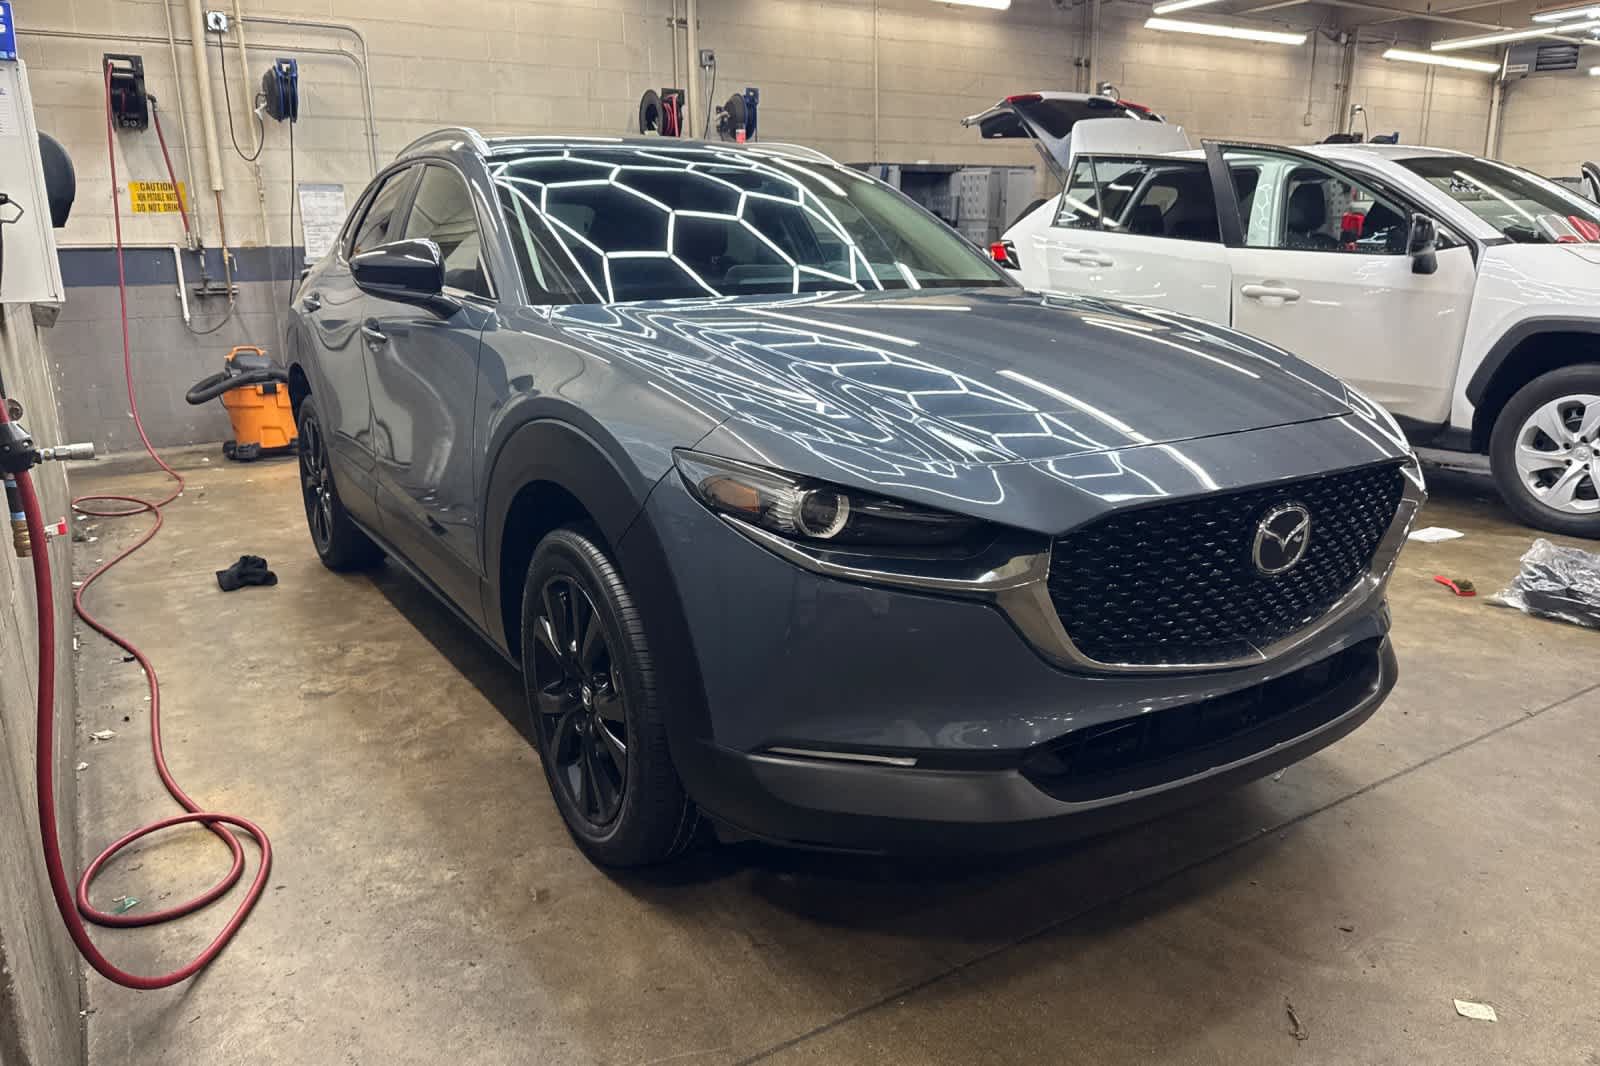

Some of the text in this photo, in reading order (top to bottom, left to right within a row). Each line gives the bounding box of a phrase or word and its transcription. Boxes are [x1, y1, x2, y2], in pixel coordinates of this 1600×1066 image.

[139, 182, 174, 191] CAUTION
[165, 193, 177, 202] WATE
[137, 203, 179, 212] DO NOT DRIN
